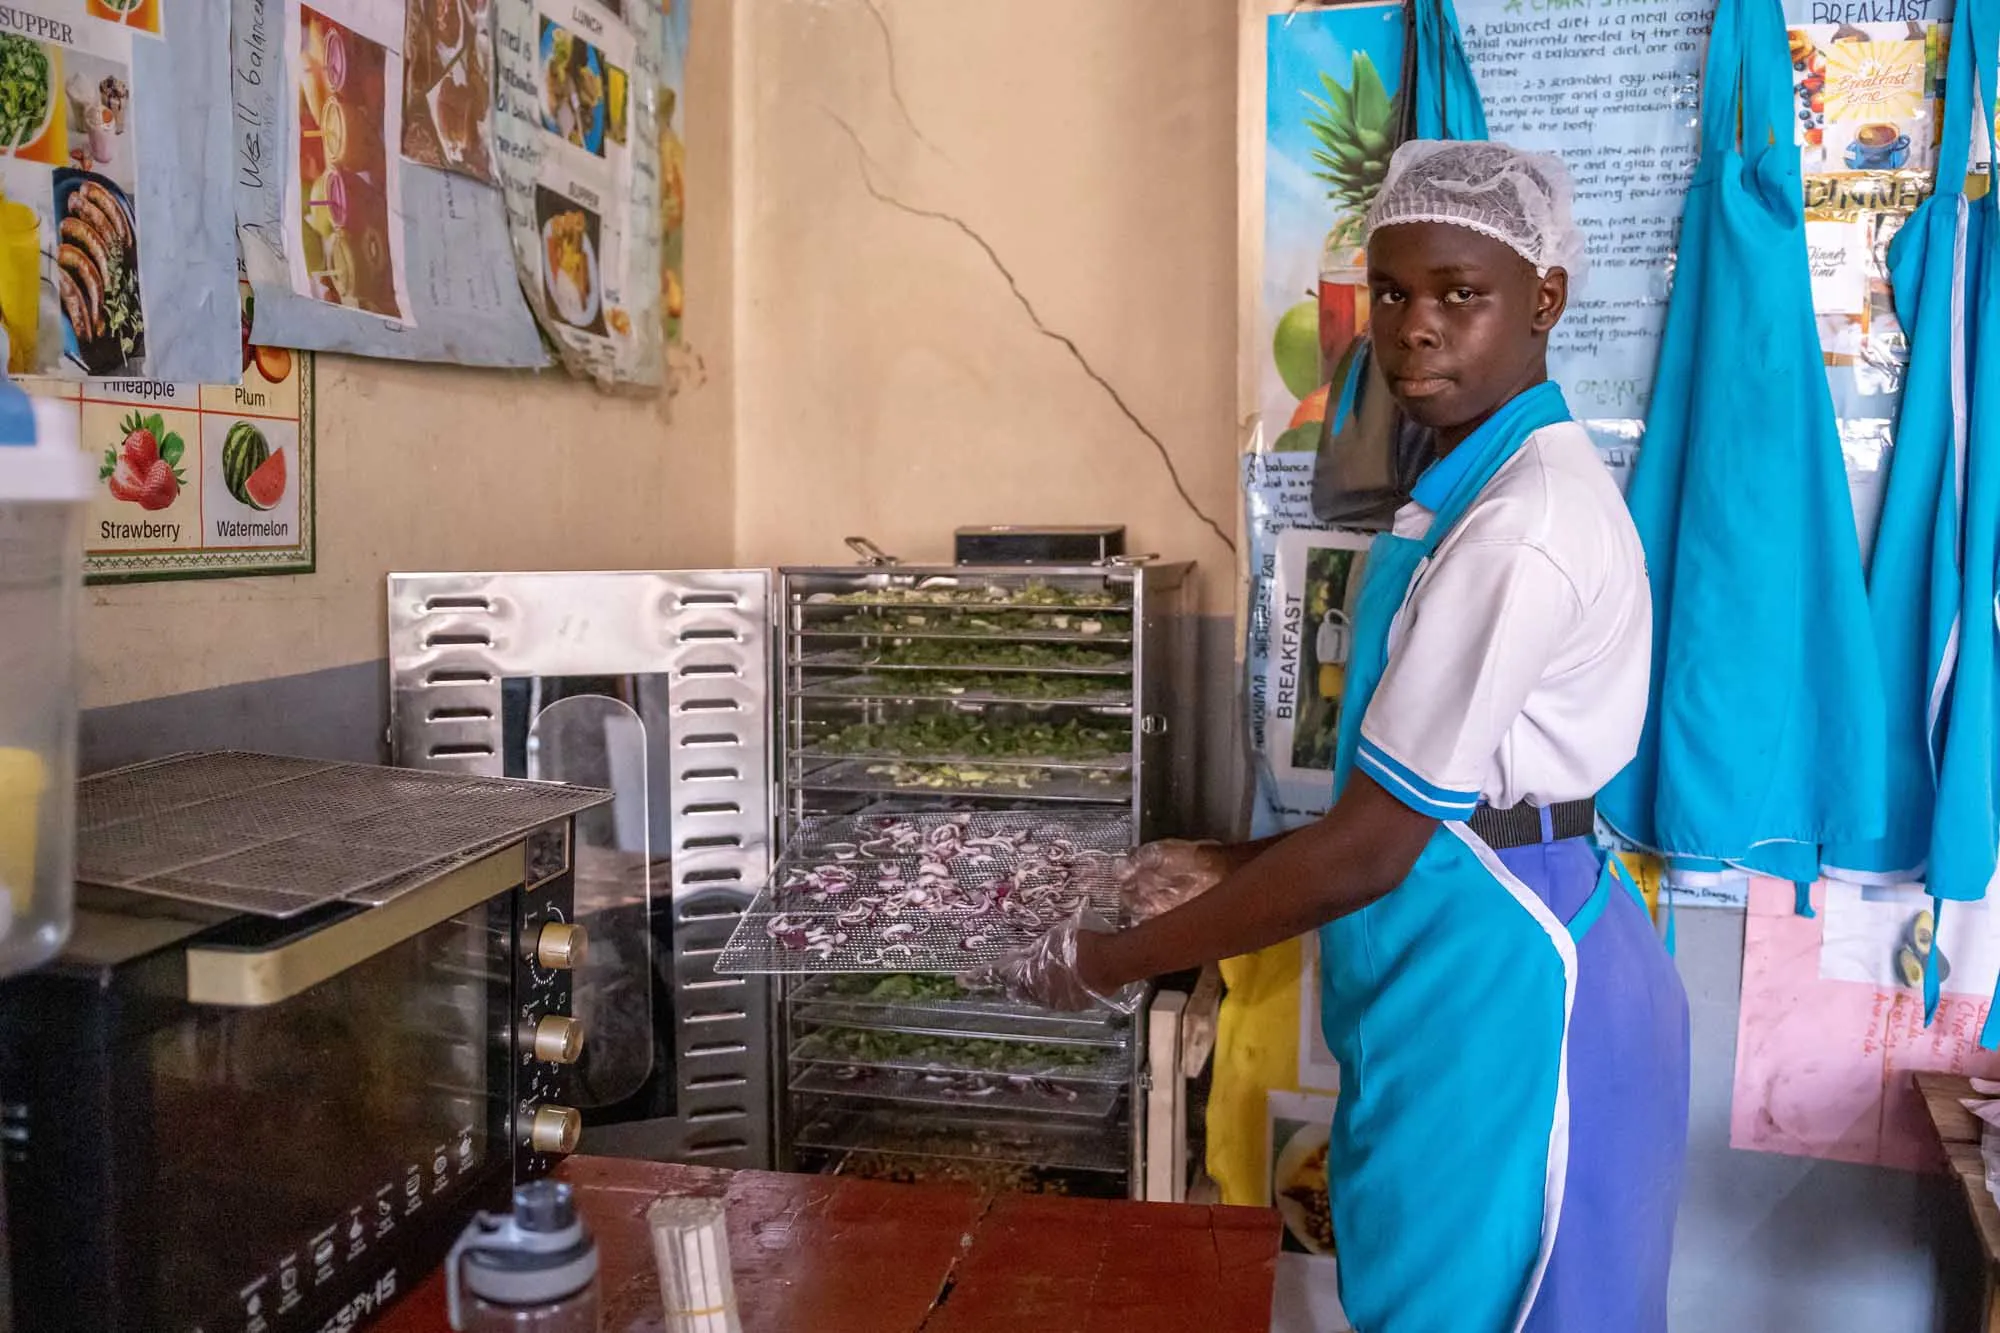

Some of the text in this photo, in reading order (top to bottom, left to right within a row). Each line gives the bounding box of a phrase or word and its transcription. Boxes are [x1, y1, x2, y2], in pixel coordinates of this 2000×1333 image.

[0, 5, 74, 45] SUPPER
[1465, 24, 1477, 36] A
[1485, 18, 1550, 36] balanced
[1557, 16, 1590, 29] diet
[1615, 14, 1626, 25] a
[1631, 11, 1667, 24] meal
[1631, 29, 1646, 43] by
[1673, 41, 1697, 53] can
[1839, 63, 1914, 92] Breakfast
[234, 386, 266, 406] Plum
[100, 520, 181, 543] Strawberry
[217, 520, 289, 538] Watermelon
[1276, 592, 1302, 720] BREAKFAST
